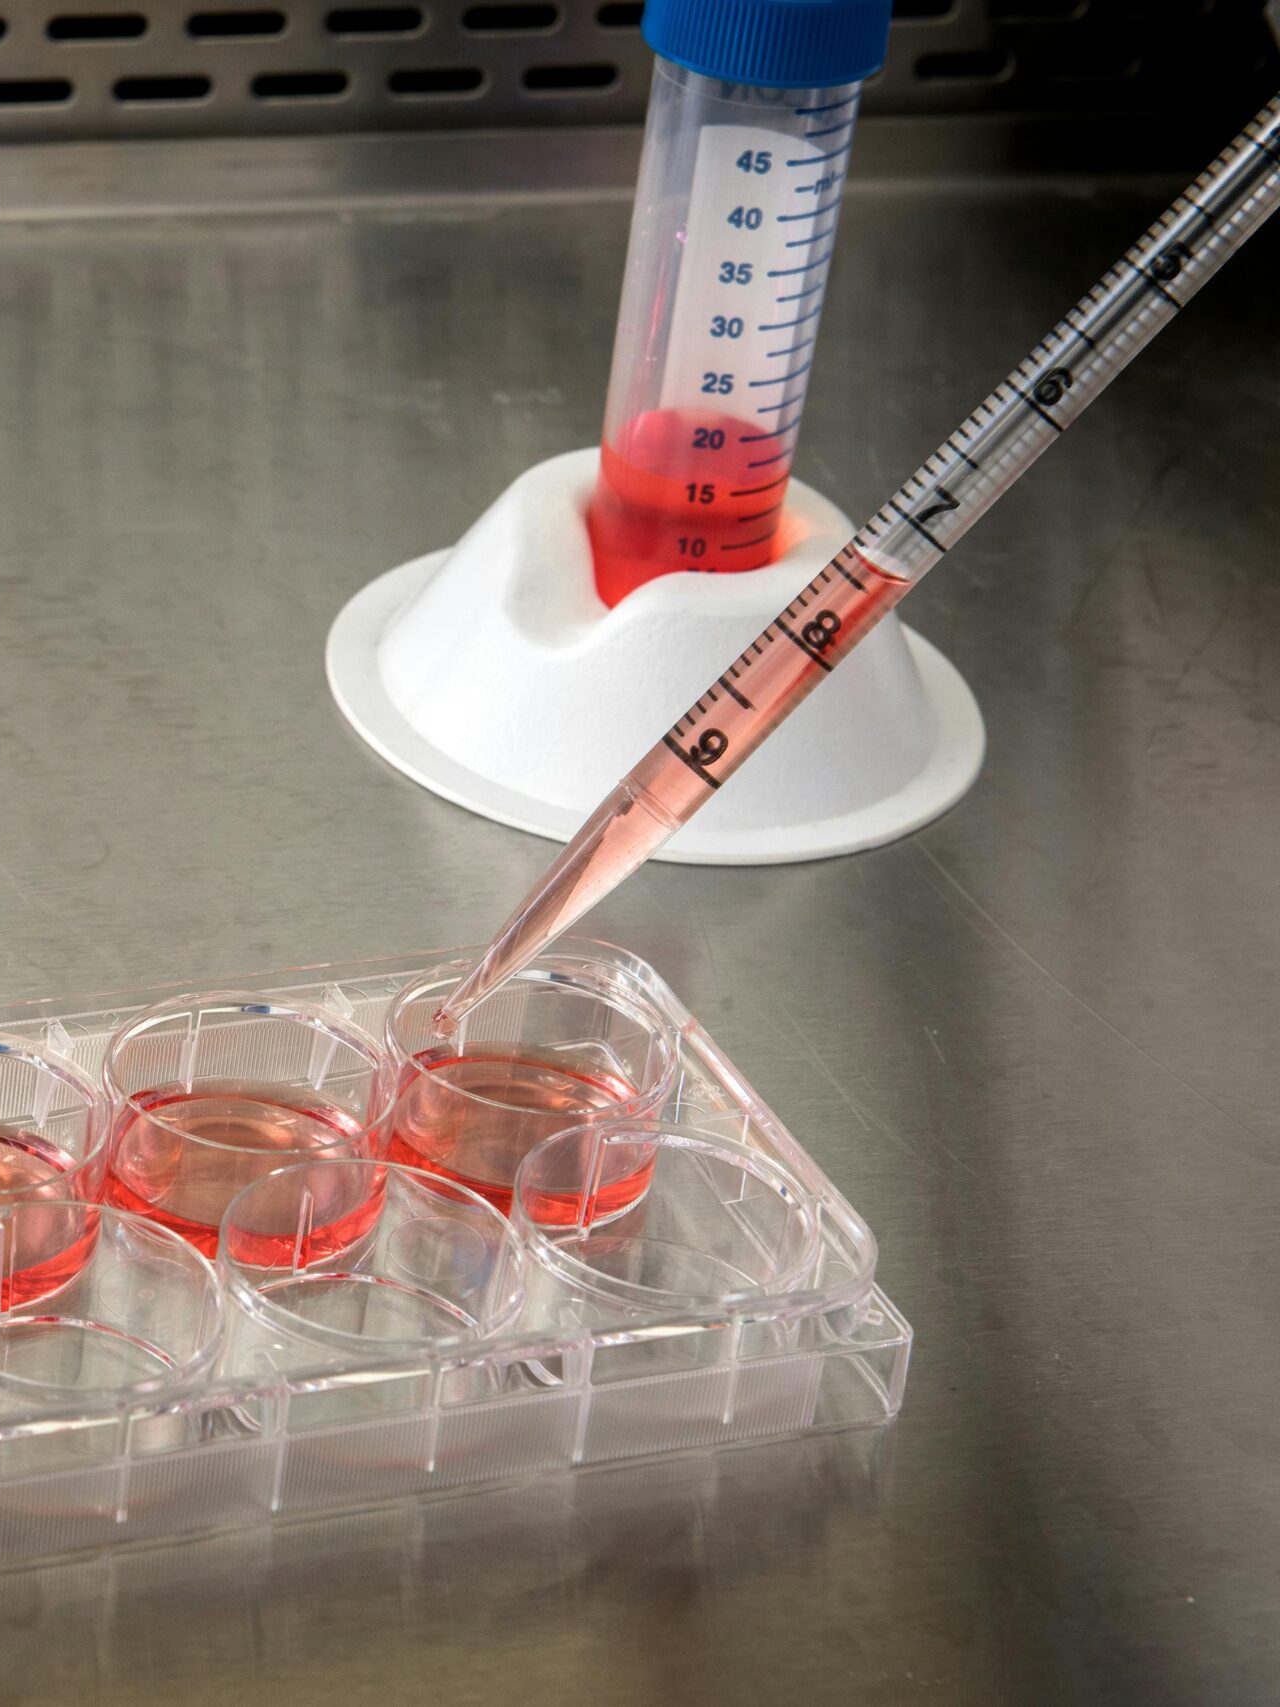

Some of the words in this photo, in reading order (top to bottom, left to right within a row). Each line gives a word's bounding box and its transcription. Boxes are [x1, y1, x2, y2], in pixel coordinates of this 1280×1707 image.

[736, 150, 772, 174] 45
[727, 207, 762, 230] 40
[718, 261, 753, 285] 35
[1150, 241, 1192, 281] 5
[710, 316, 744, 339] 30
[701, 372, 734, 395] 25
[1033, 366, 1073, 406] 6
[692, 428, 725, 450] 20
[686, 483, 716, 504] 15
[918, 485, 961, 524] 7
[678, 537, 707, 558] 10
[801, 609, 842, 651] 8
[690, 728, 729, 766] 9
